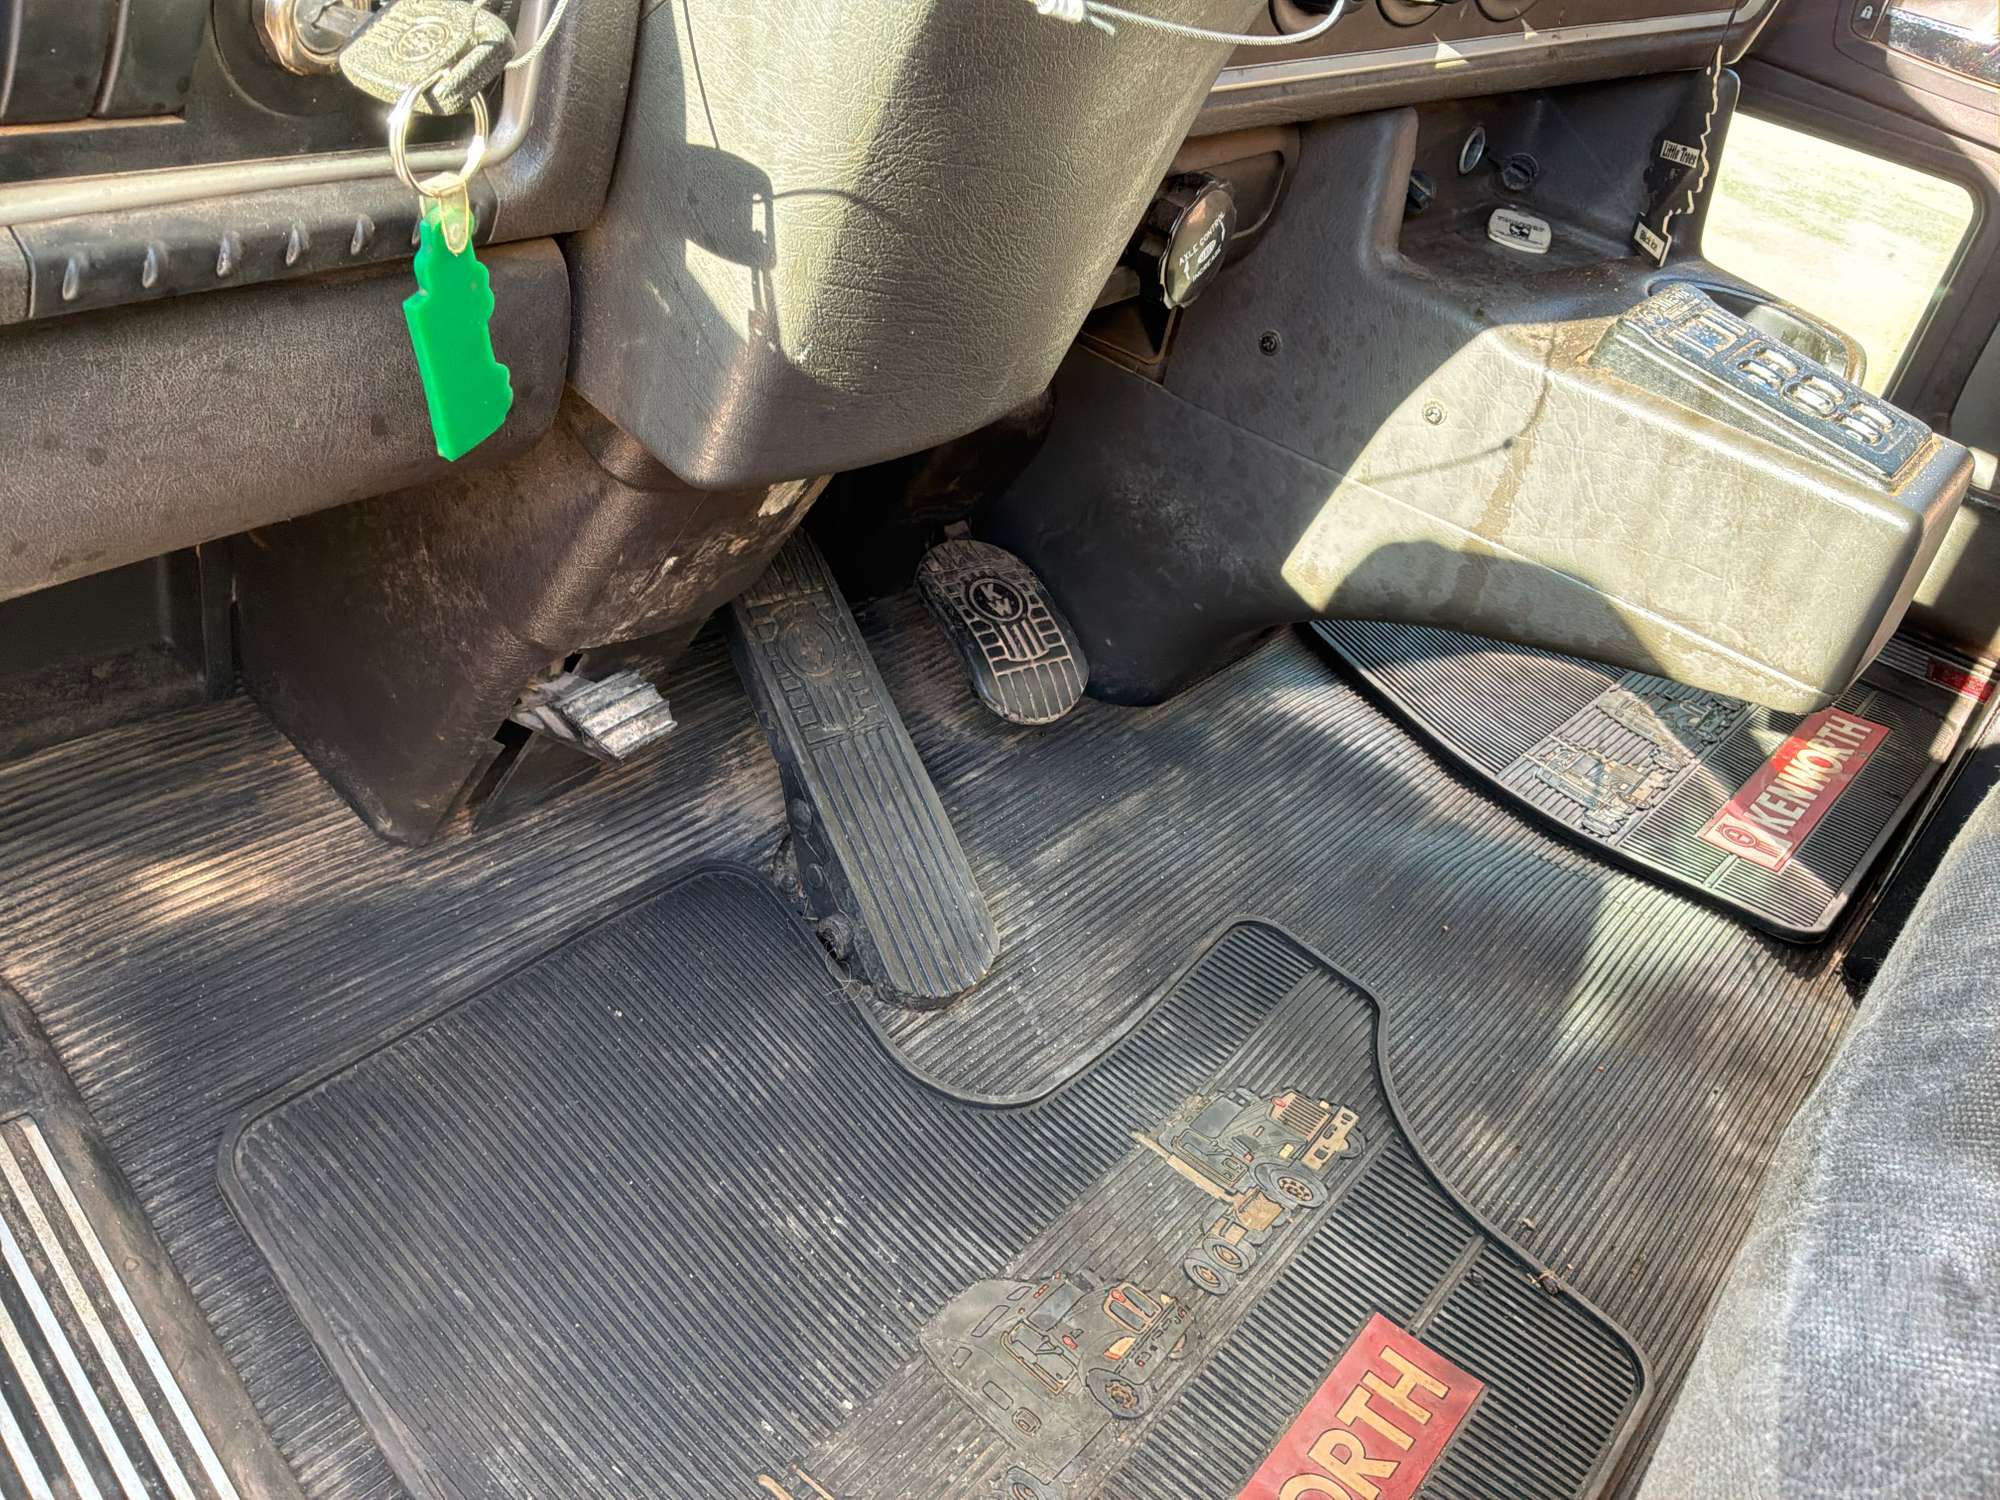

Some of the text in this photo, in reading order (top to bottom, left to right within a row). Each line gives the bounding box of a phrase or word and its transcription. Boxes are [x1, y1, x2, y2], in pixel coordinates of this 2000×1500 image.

[1662, 142, 1697, 165] Little Trees
[1179, 242, 1199, 266] AXLE
[1744, 714, 1873, 835] KENWORTH
